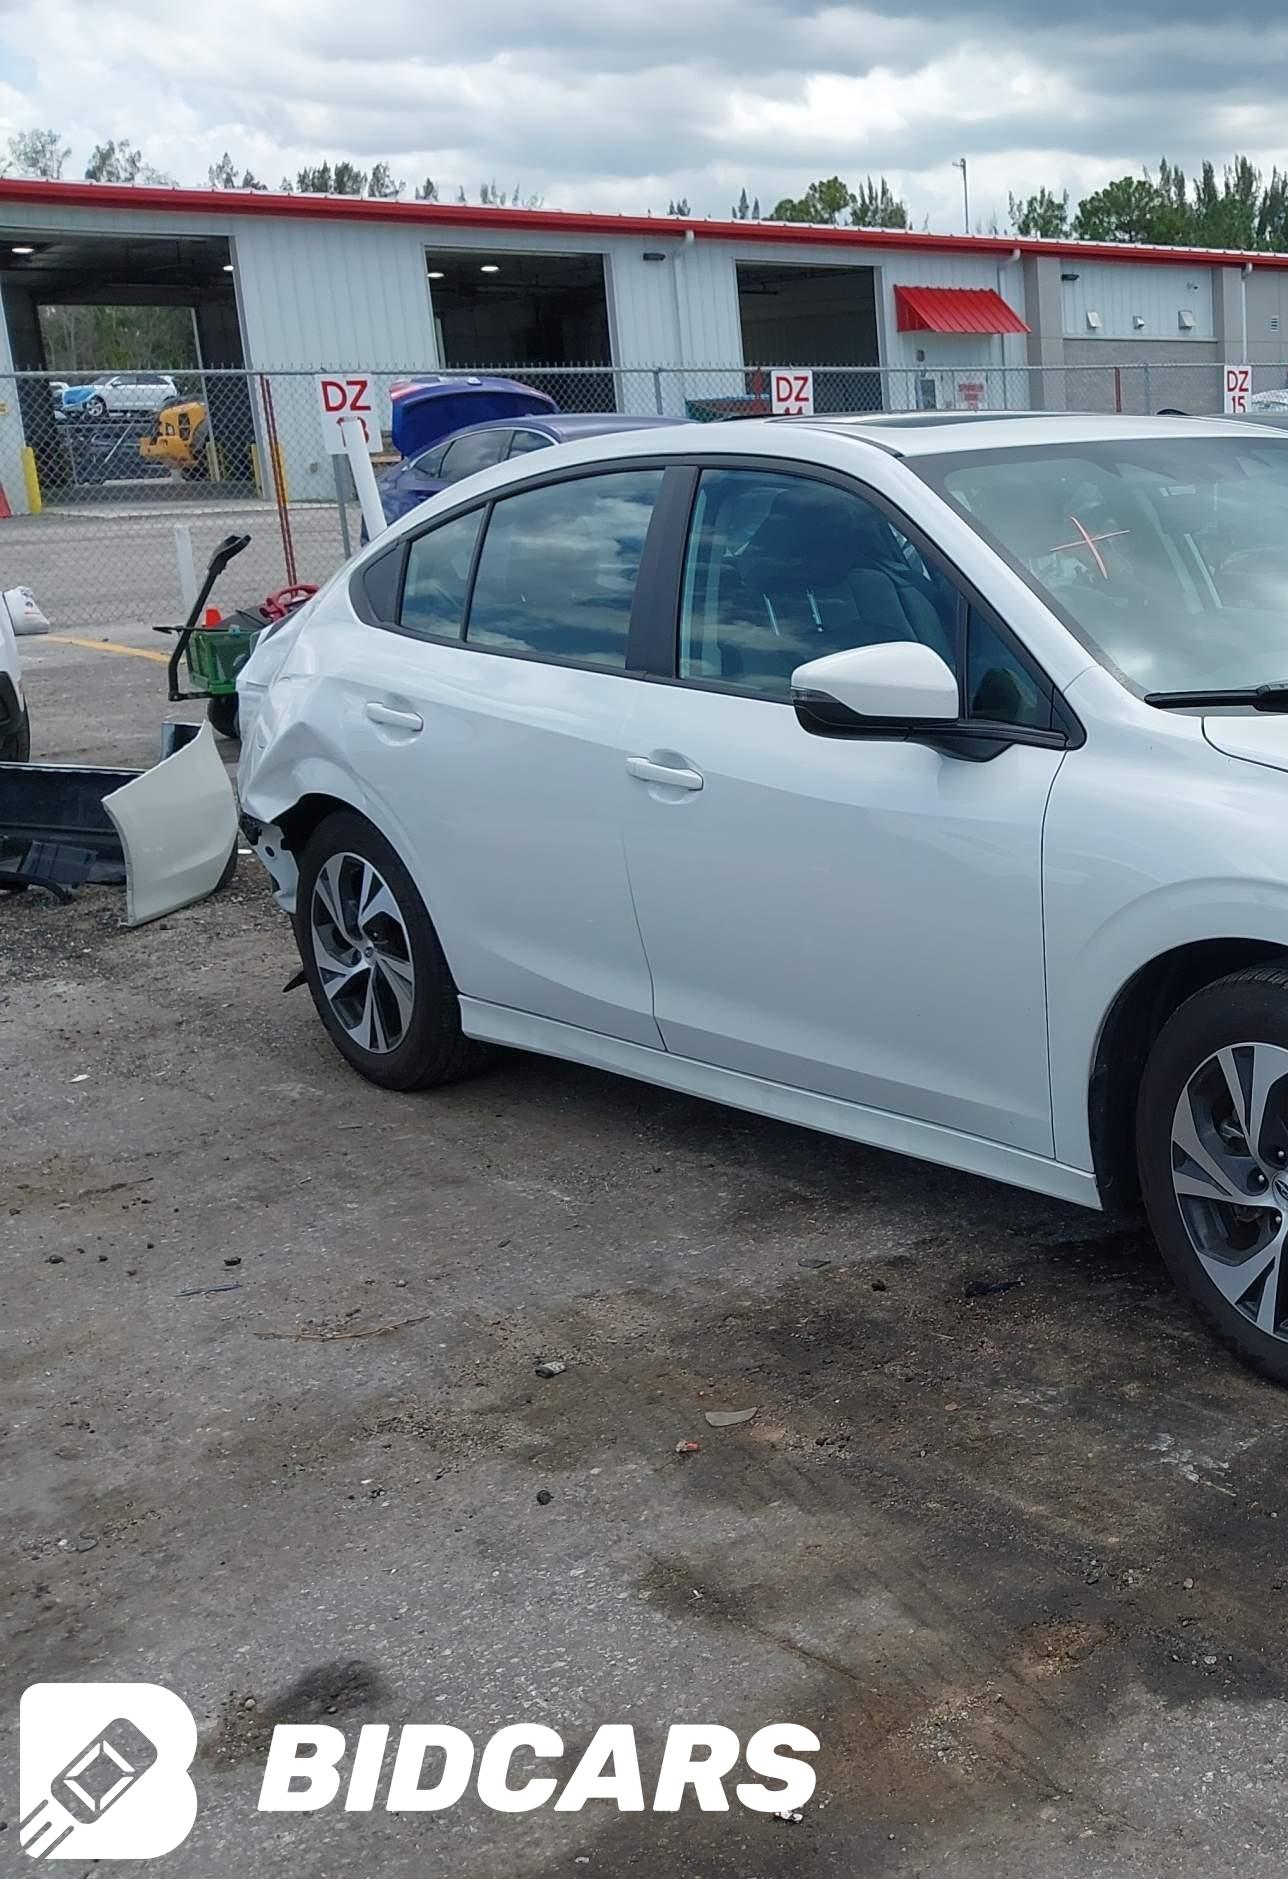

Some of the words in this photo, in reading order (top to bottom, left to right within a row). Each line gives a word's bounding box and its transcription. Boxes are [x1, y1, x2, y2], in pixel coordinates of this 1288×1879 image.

[775, 376, 809, 402] DZ
[1227, 370, 1249, 392] DZ
[321, 380, 371, 412] DZ
[1232, 396, 1246, 413] 15
